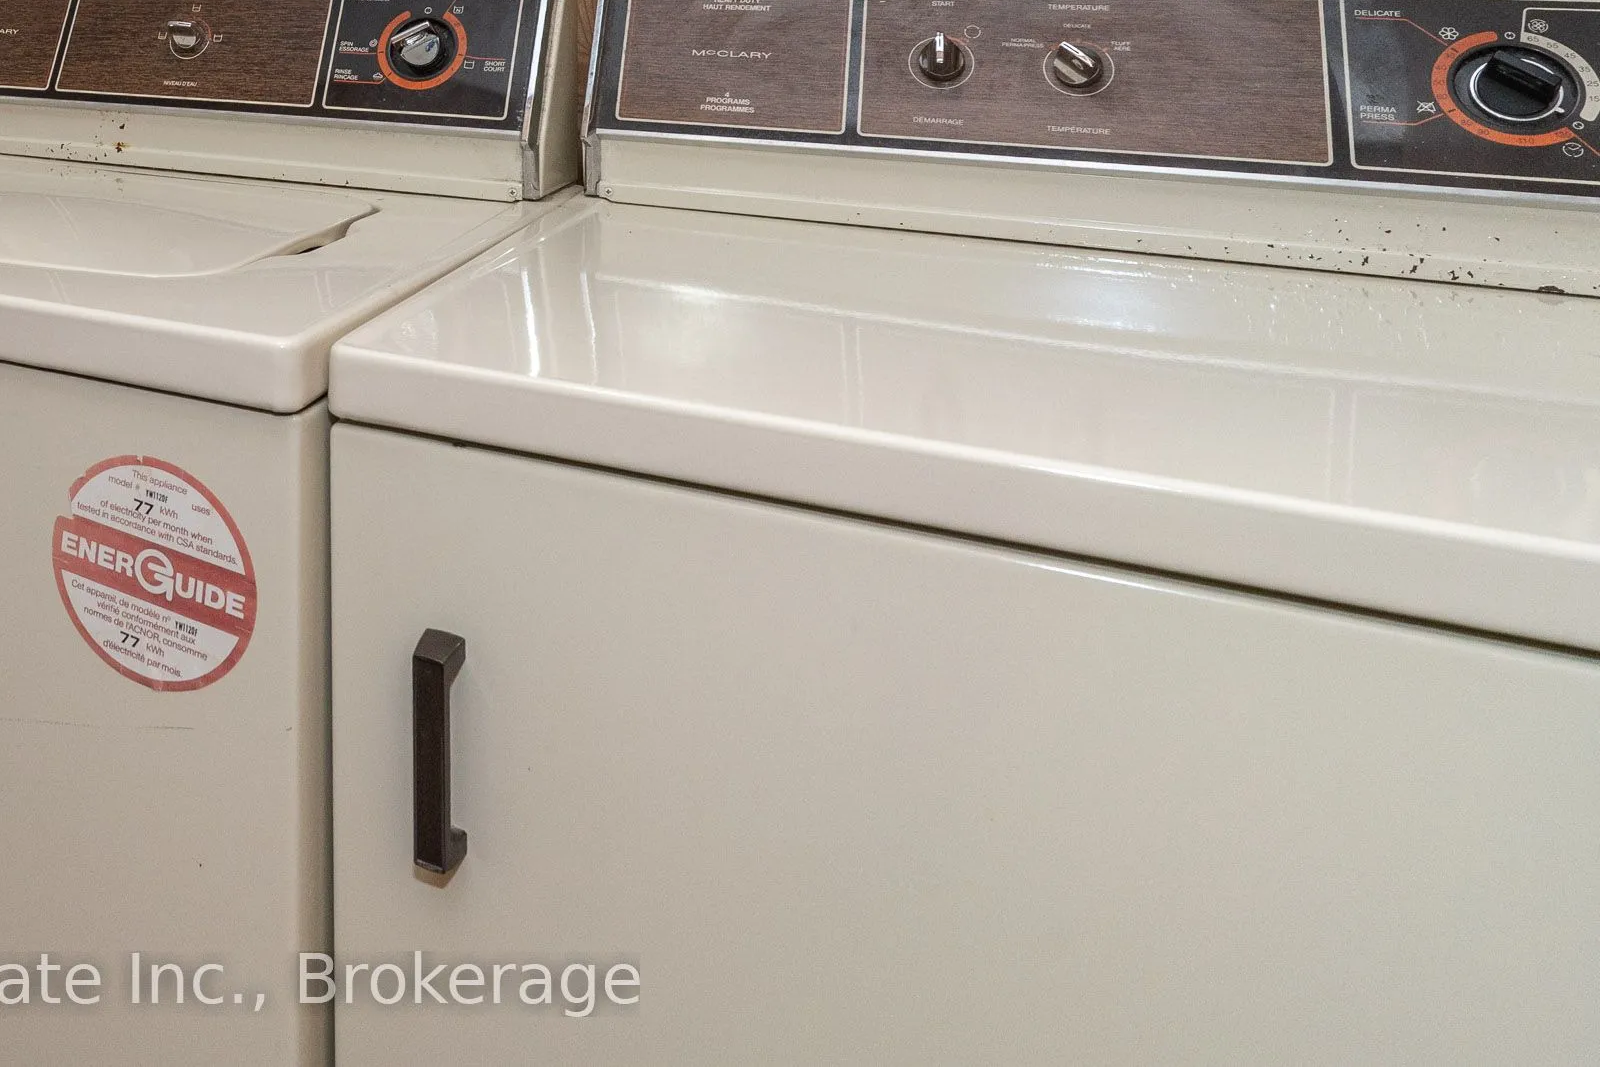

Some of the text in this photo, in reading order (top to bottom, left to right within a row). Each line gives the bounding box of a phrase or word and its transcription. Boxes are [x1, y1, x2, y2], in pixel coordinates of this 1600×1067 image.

[1048, 4, 1110, 12] TEMPERATURE
[1354, 9, 1401, 17] DELICATE
[692, 49, 773, 59] McCLARY
[700, 104, 756, 114] PROGRAMMES
[706, 97, 751, 106] PROGRAMS
[1360, 105, 1397, 113] PERMA
[1360, 113, 1395, 121] PRESS
[108, 474, 132, 489] model
[132, 470, 188, 496] This appliance
[133, 498, 179, 520] 77 kWh
[191, 502, 212, 516] uses
[100, 498, 214, 546] of electricity per month when
[77, 502, 238, 566] tested in accordance with CSA standards.
[60, 530, 246, 620] ENERGUIDE
[71, 578, 85, 591] Cet
[86, 587, 118, 606] appareil,
[118, 598, 130, 608] de
[83, 606, 208, 662] normes de l'ACNOR, consomme
[97, 601, 196, 646] vérifié conformément aux
[120, 630, 165, 658] 77 kWh
[146, 656, 161, 670] par
[161, 662, 183, 678] mois.
